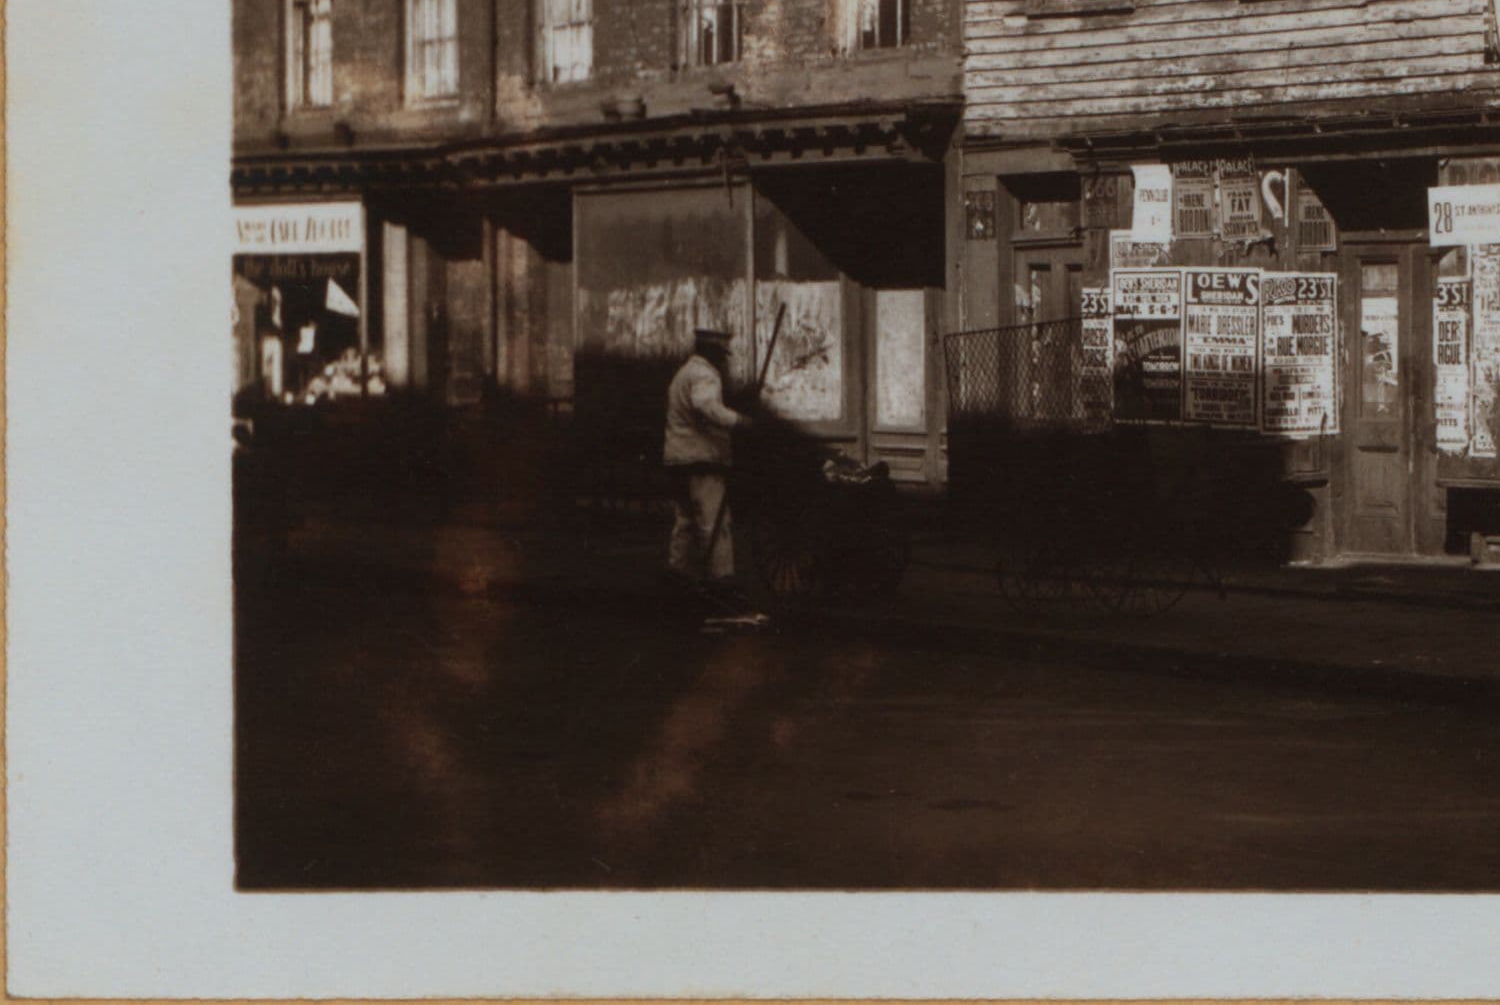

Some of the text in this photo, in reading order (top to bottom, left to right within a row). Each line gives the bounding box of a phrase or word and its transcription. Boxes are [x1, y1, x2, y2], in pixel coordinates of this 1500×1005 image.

[1231, 198, 1251, 213] FAY
[1434, 202, 1453, 235] 28
[1186, 273, 1258, 305] LOEW'S
